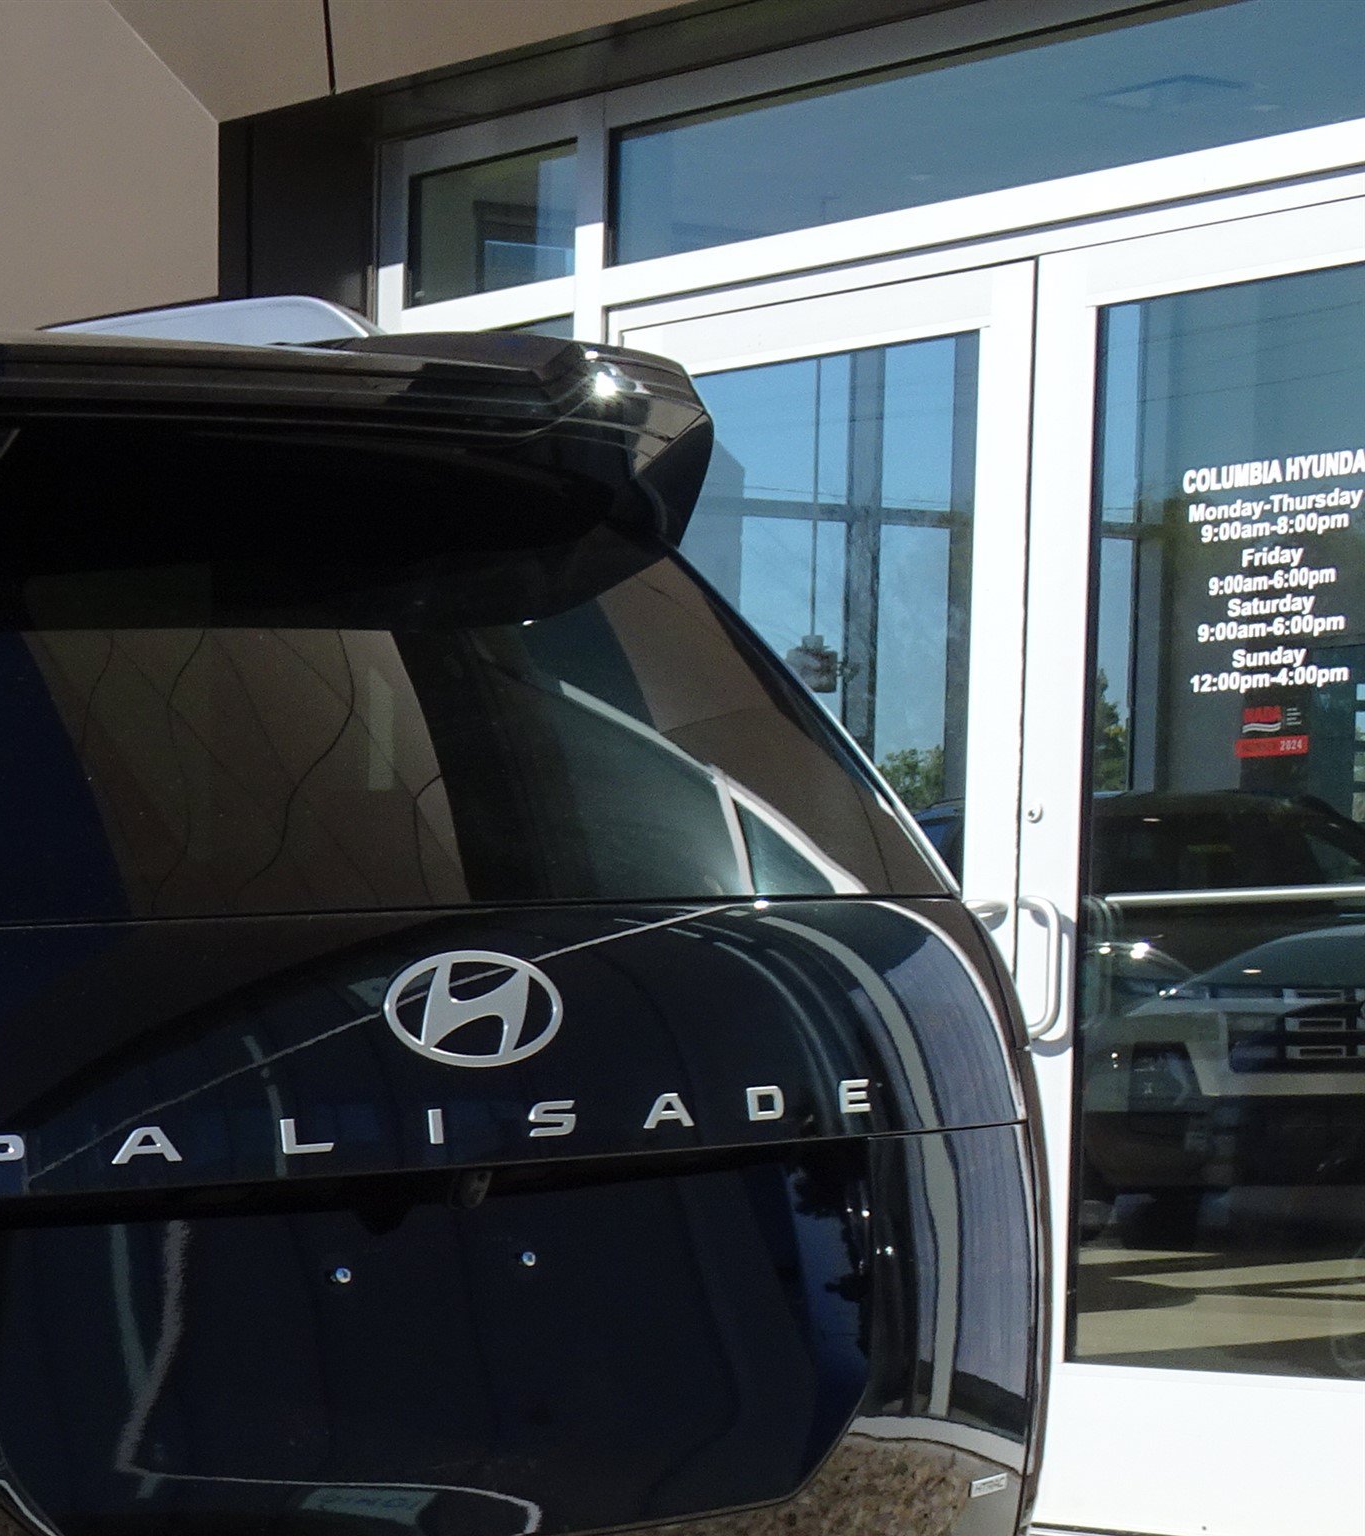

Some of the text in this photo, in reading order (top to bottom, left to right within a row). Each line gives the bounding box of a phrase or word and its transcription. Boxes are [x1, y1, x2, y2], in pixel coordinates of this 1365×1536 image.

[1182, 459, 1283, 494] COLUMBIA
[1188, 487, 1364, 523] Monday-Thursday
[1200, 512, 1350, 543] 9:00am-8:00pm
[1241, 545, 1304, 568] Friday
[1208, 567, 1337, 596] 9:00am-6:00pm
[1227, 593, 1316, 618] Saturday
[1197, 614, 1346, 643] 9:00am-6:00pm
[1231, 645, 1307, 669] Sunday
[1189, 665, 1350, 694] 12:00pm-4:00pm
